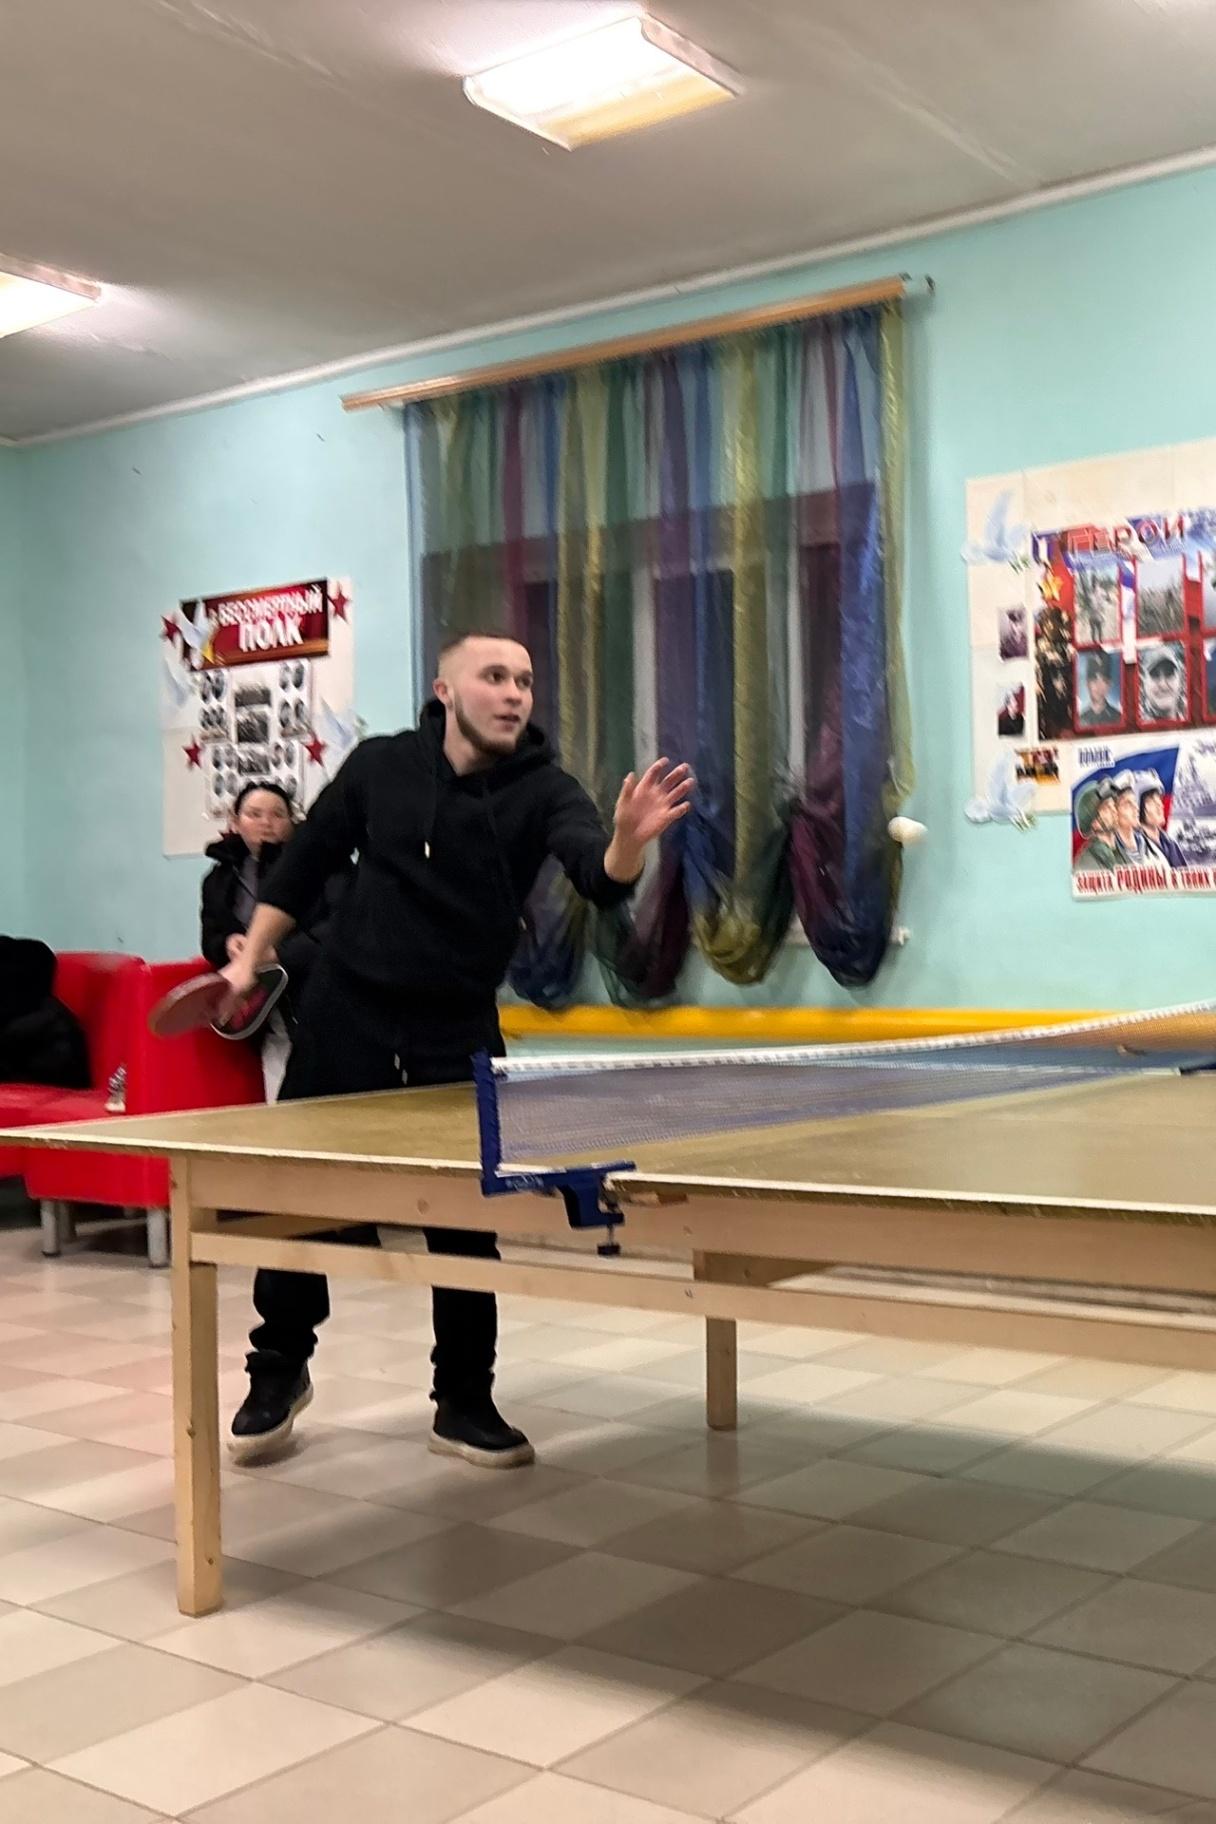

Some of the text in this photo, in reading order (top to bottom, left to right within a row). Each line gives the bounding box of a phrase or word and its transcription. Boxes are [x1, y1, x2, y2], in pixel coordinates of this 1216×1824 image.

[239, 611, 303, 652] ПОЛК
[1077, 874, 1114, 894] ЗАЩИТА
[1116, 866, 1168, 893] РОДИНЫ
